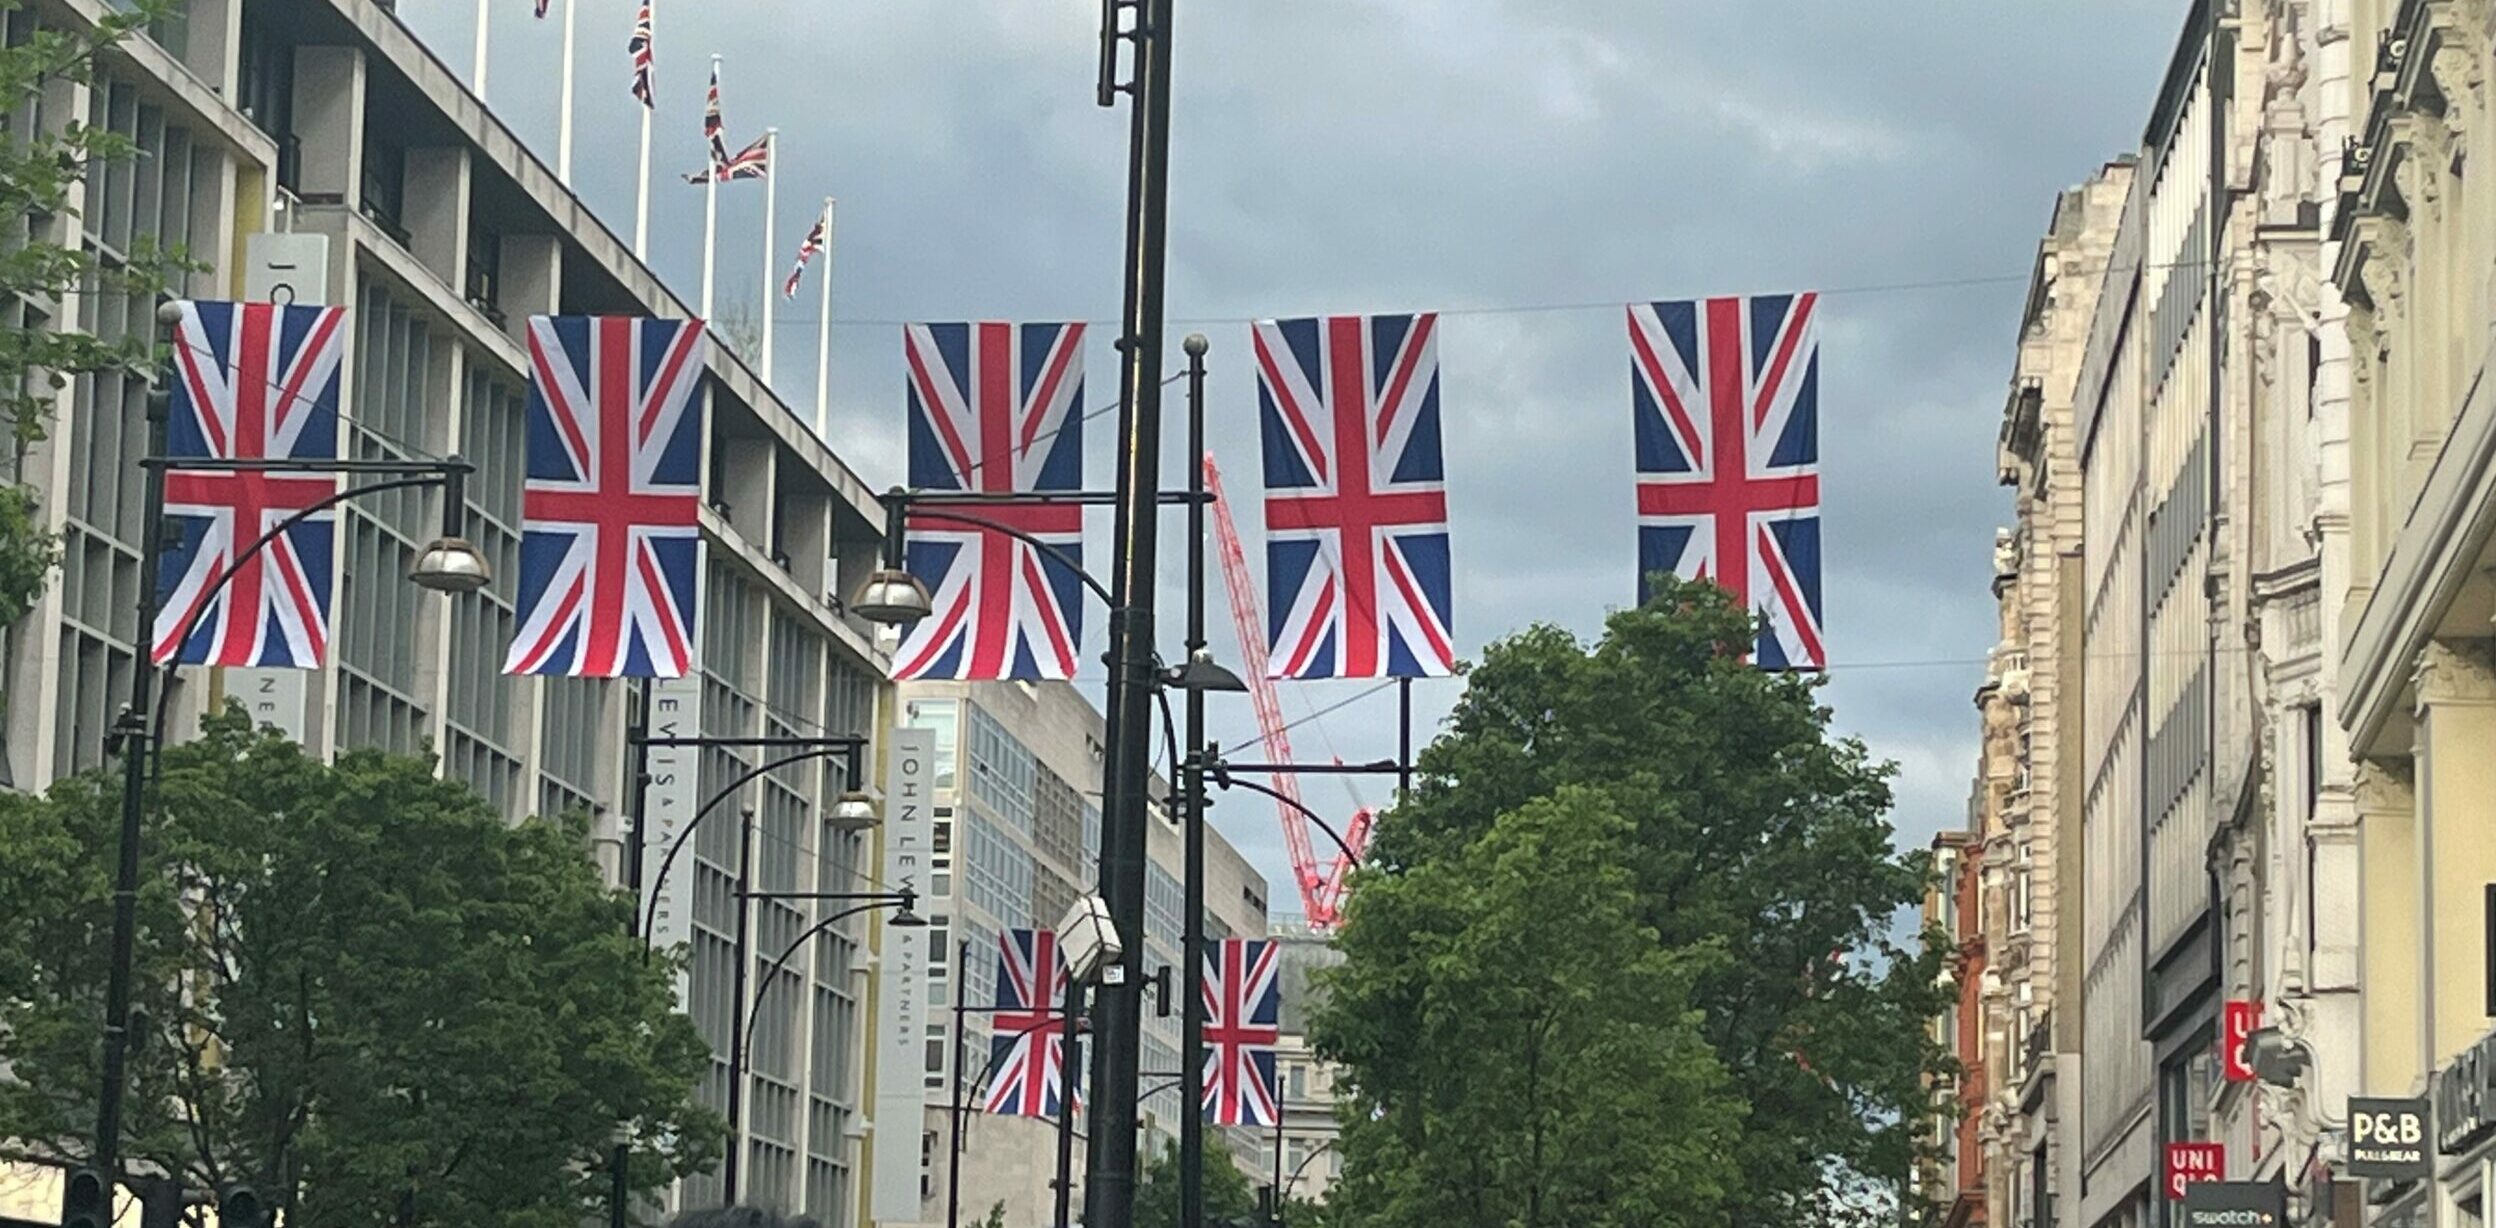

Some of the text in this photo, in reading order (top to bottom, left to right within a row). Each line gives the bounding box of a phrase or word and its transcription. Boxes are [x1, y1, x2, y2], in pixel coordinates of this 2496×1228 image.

[268, 262, 296, 304] JO
[901, 746, 919, 821] JOHN
[656, 819, 674, 934] PARNERS
[2354, 1112, 2422, 1144] P&B
[2172, 1150, 2214, 1170] UNI
[2192, 1210, 2261, 1225] swatch
